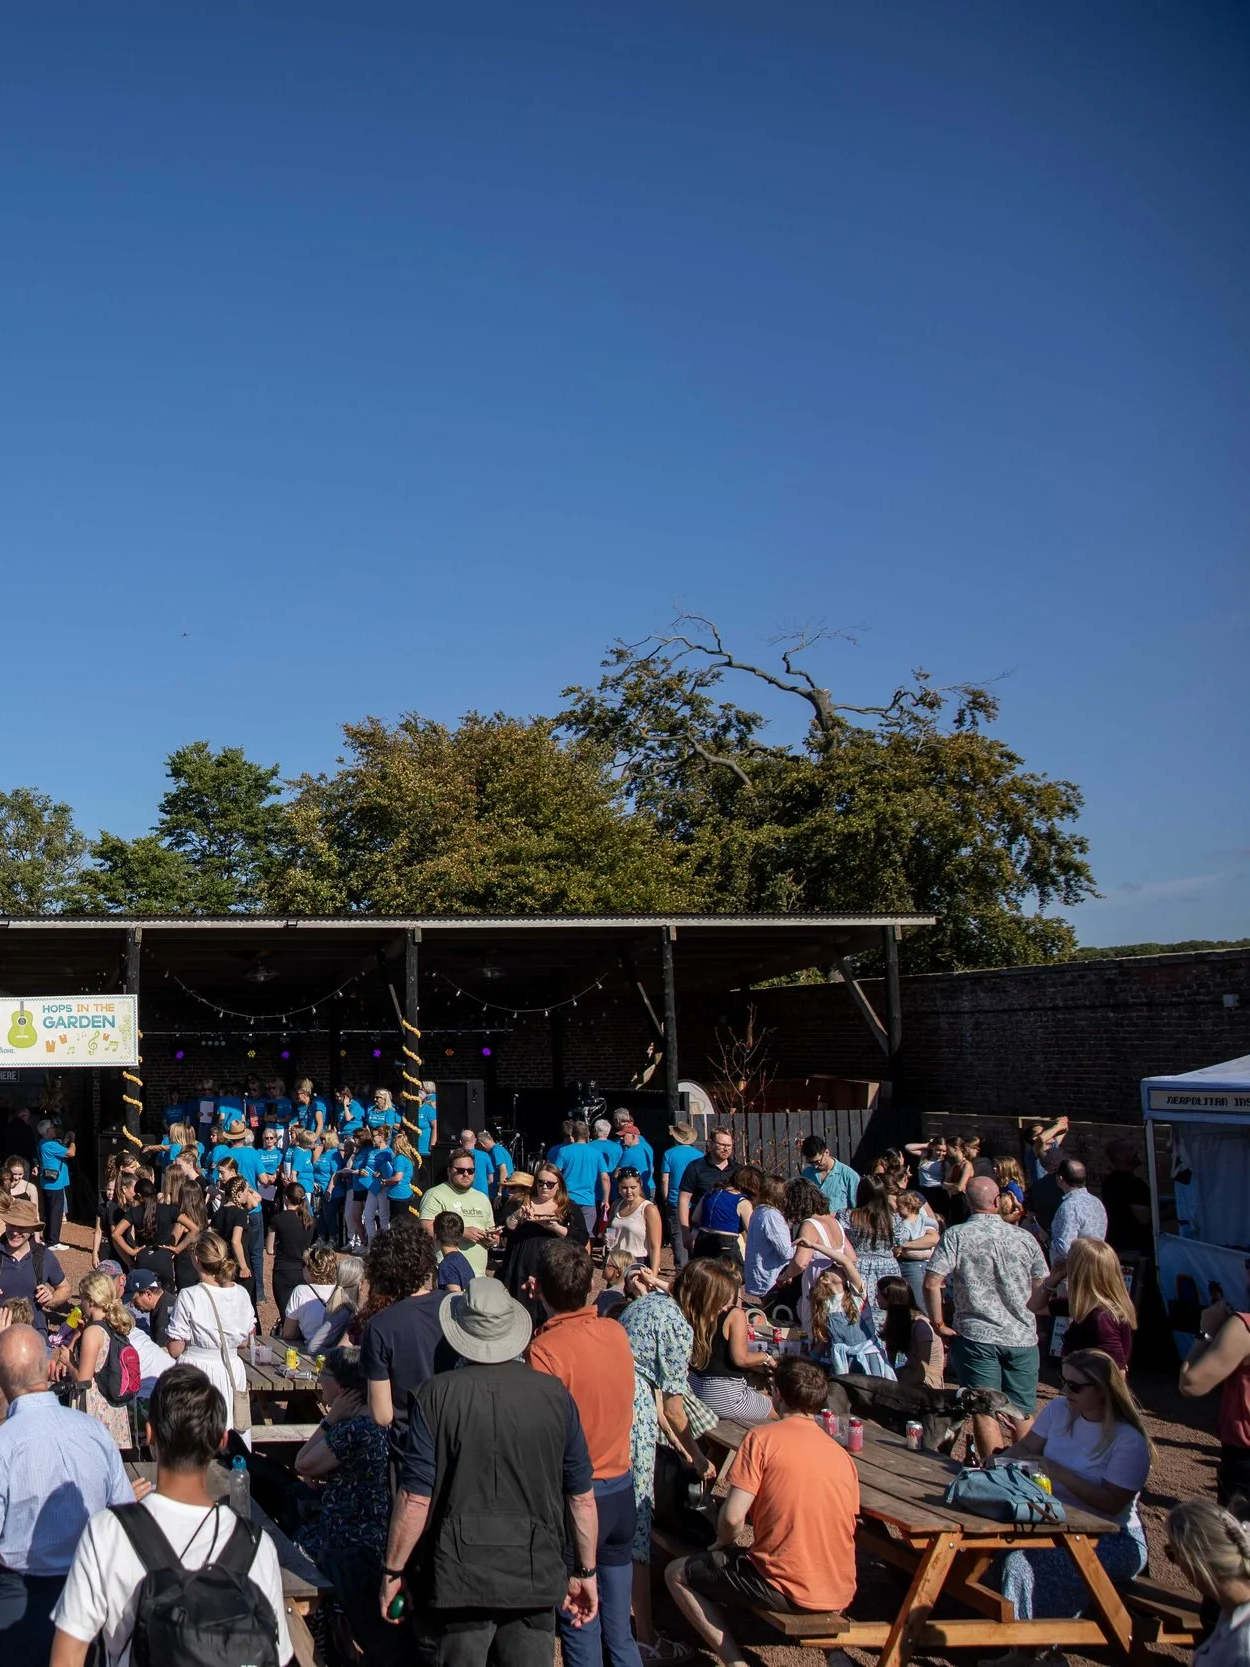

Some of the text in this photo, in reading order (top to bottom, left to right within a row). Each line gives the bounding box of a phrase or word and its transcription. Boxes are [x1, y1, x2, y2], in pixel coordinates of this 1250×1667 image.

[43, 1004, 115, 1013] HOPS IN THE
[42, 1015, 115, 1028] GARDEN
[1166, 1096, 1228, 1106] NEAPOLITAN
